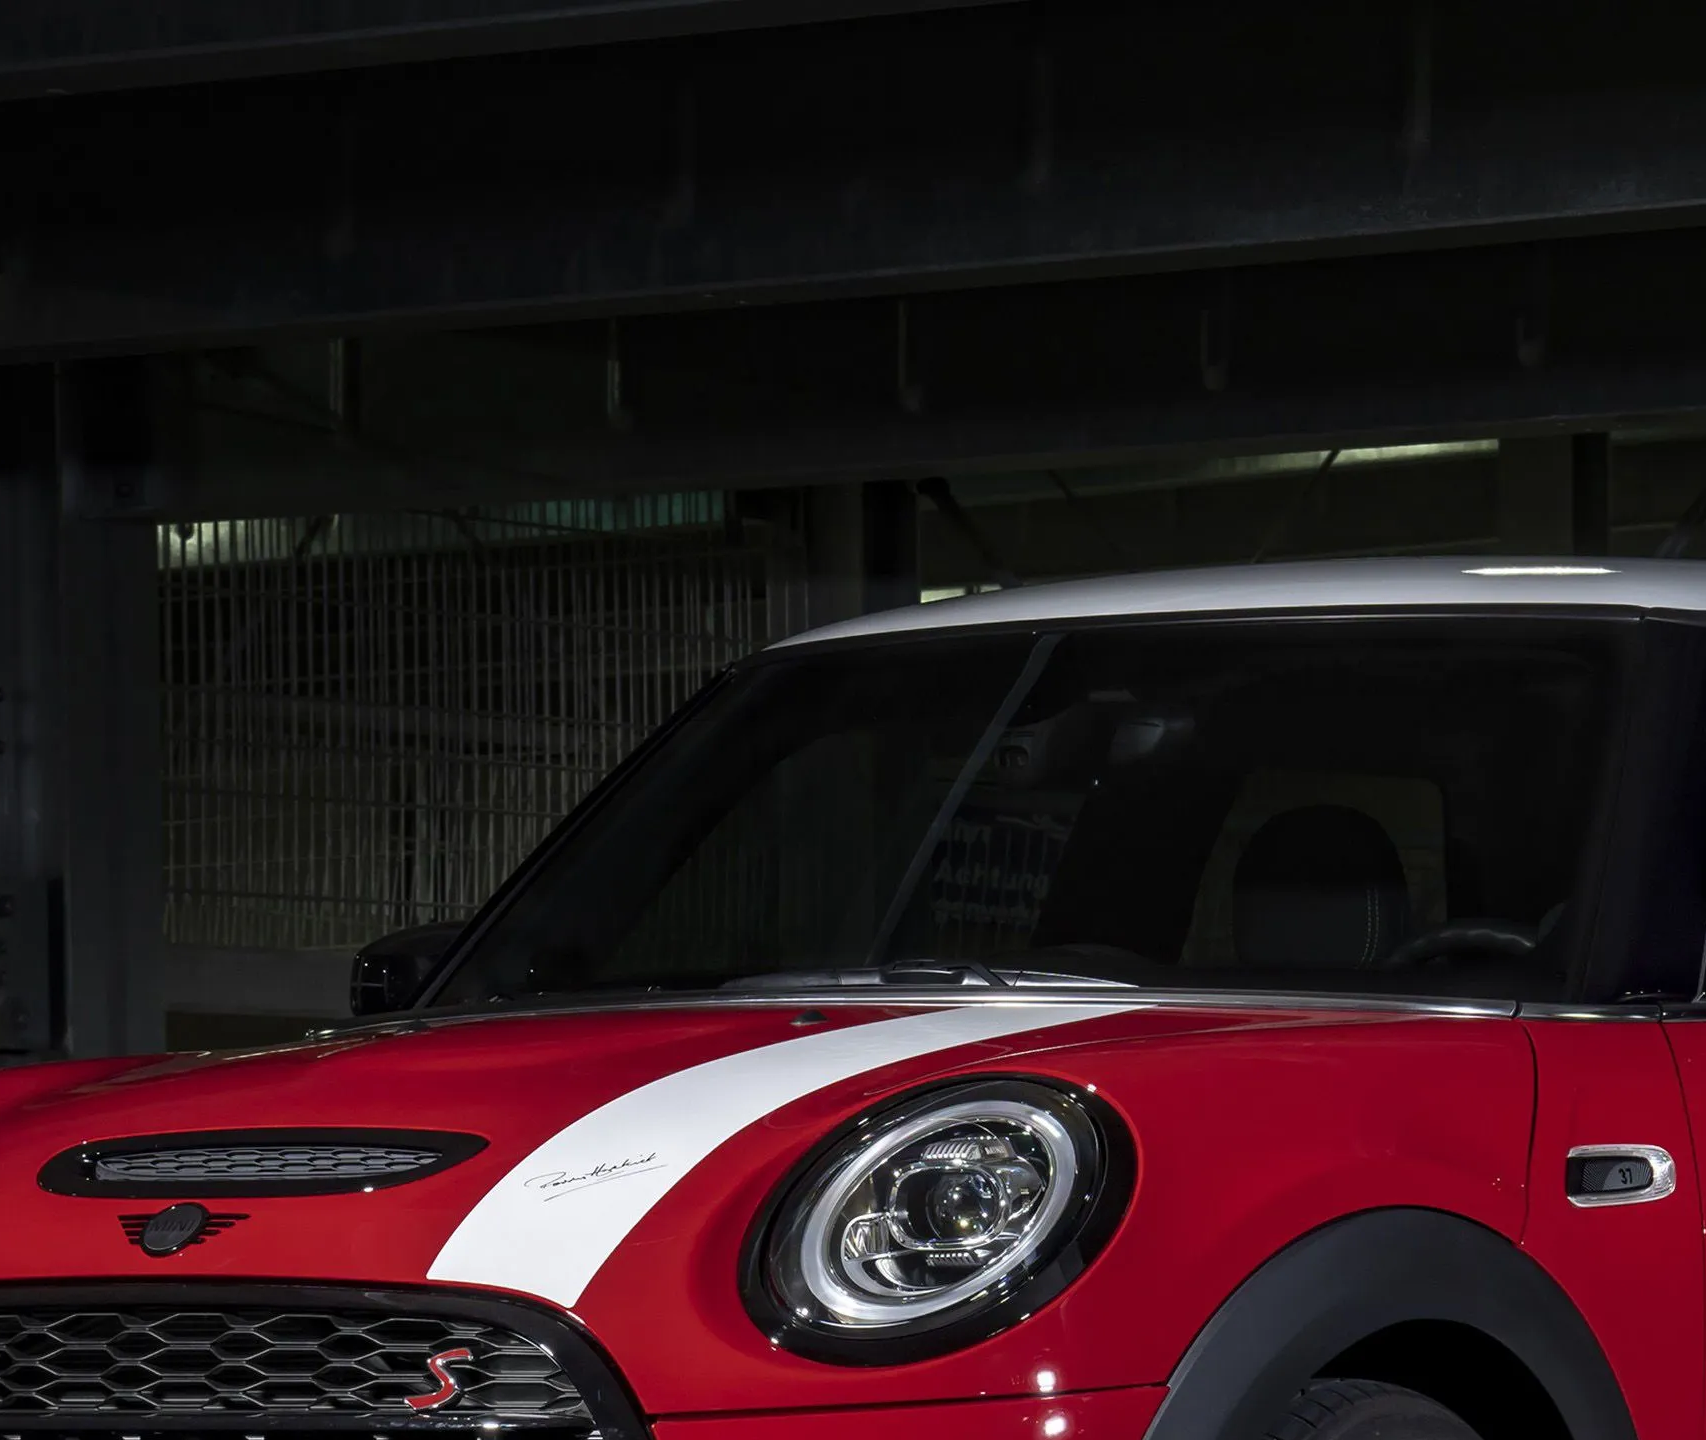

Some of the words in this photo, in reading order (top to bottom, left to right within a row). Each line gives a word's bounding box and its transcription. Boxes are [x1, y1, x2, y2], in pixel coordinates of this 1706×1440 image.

[1618, 1166, 1633, 1185] 37
[146, 1219, 199, 1232] MINI
[404, 1347, 474, 1410] S
